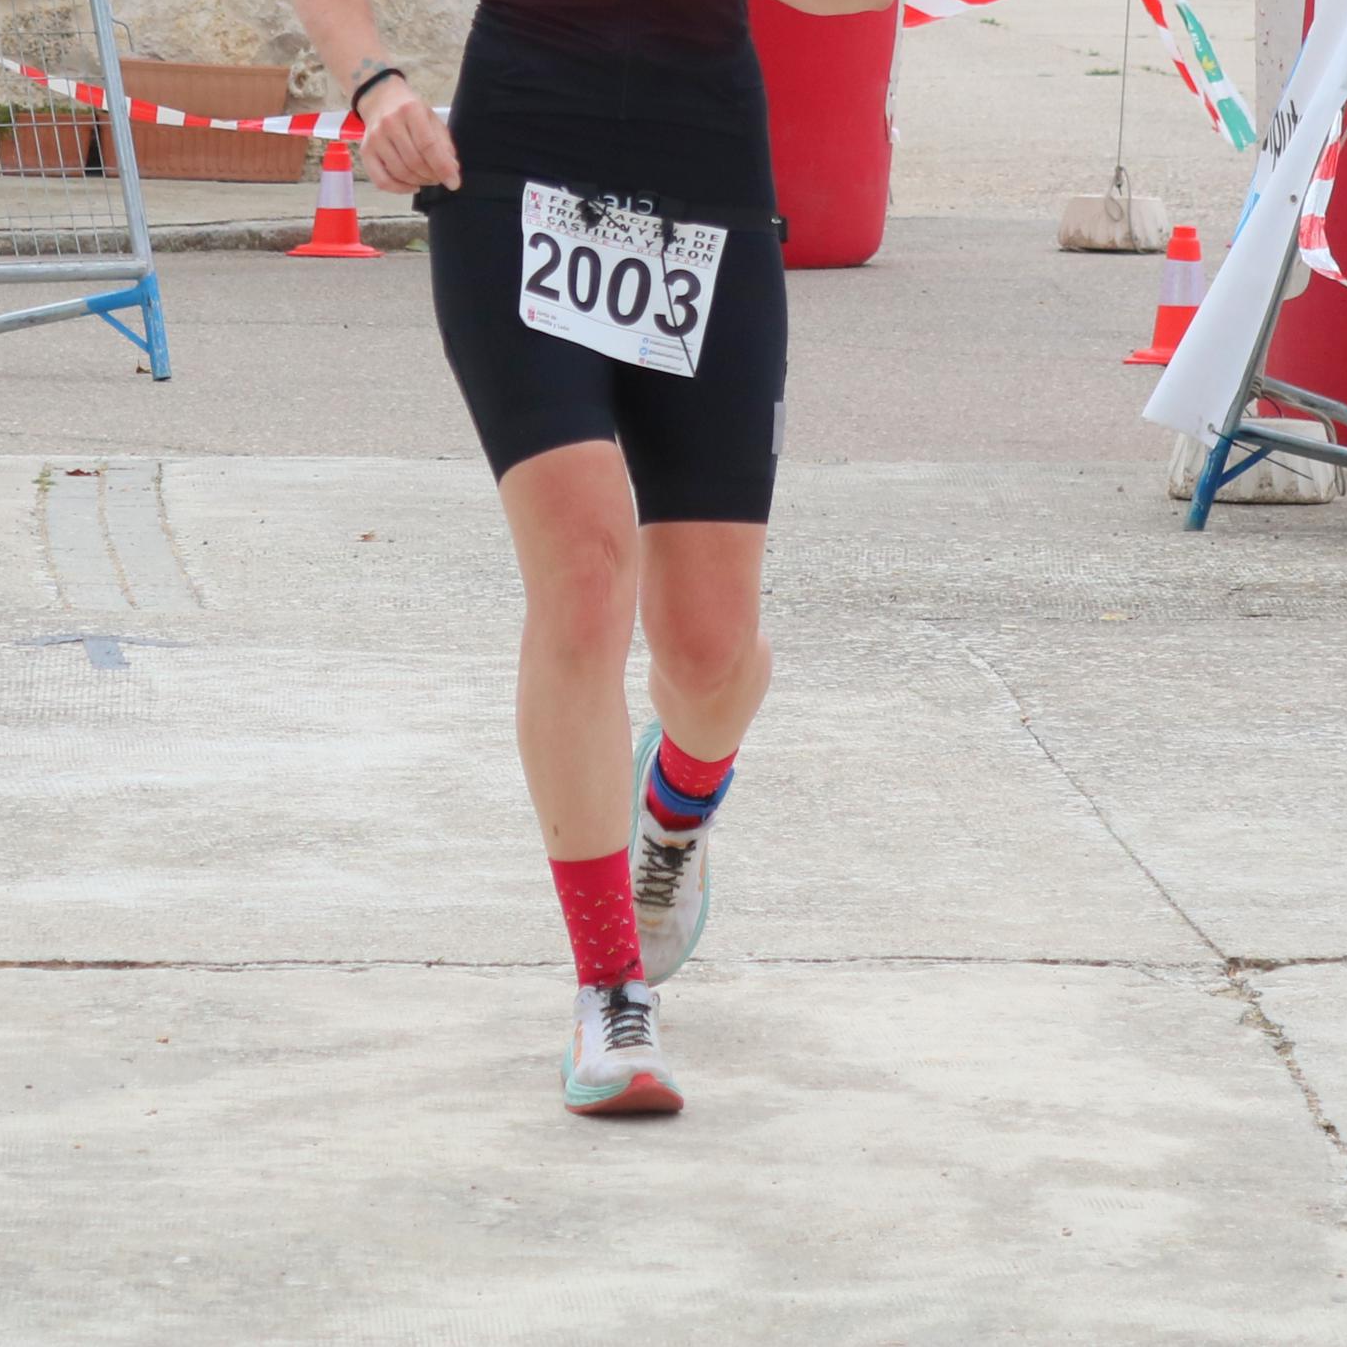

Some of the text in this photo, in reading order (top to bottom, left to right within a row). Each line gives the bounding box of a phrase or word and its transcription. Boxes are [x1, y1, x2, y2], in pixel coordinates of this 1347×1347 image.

[695, 230, 720, 243] DE
[693, 240, 717, 252] DE
[525, 232, 702, 338] 2003
